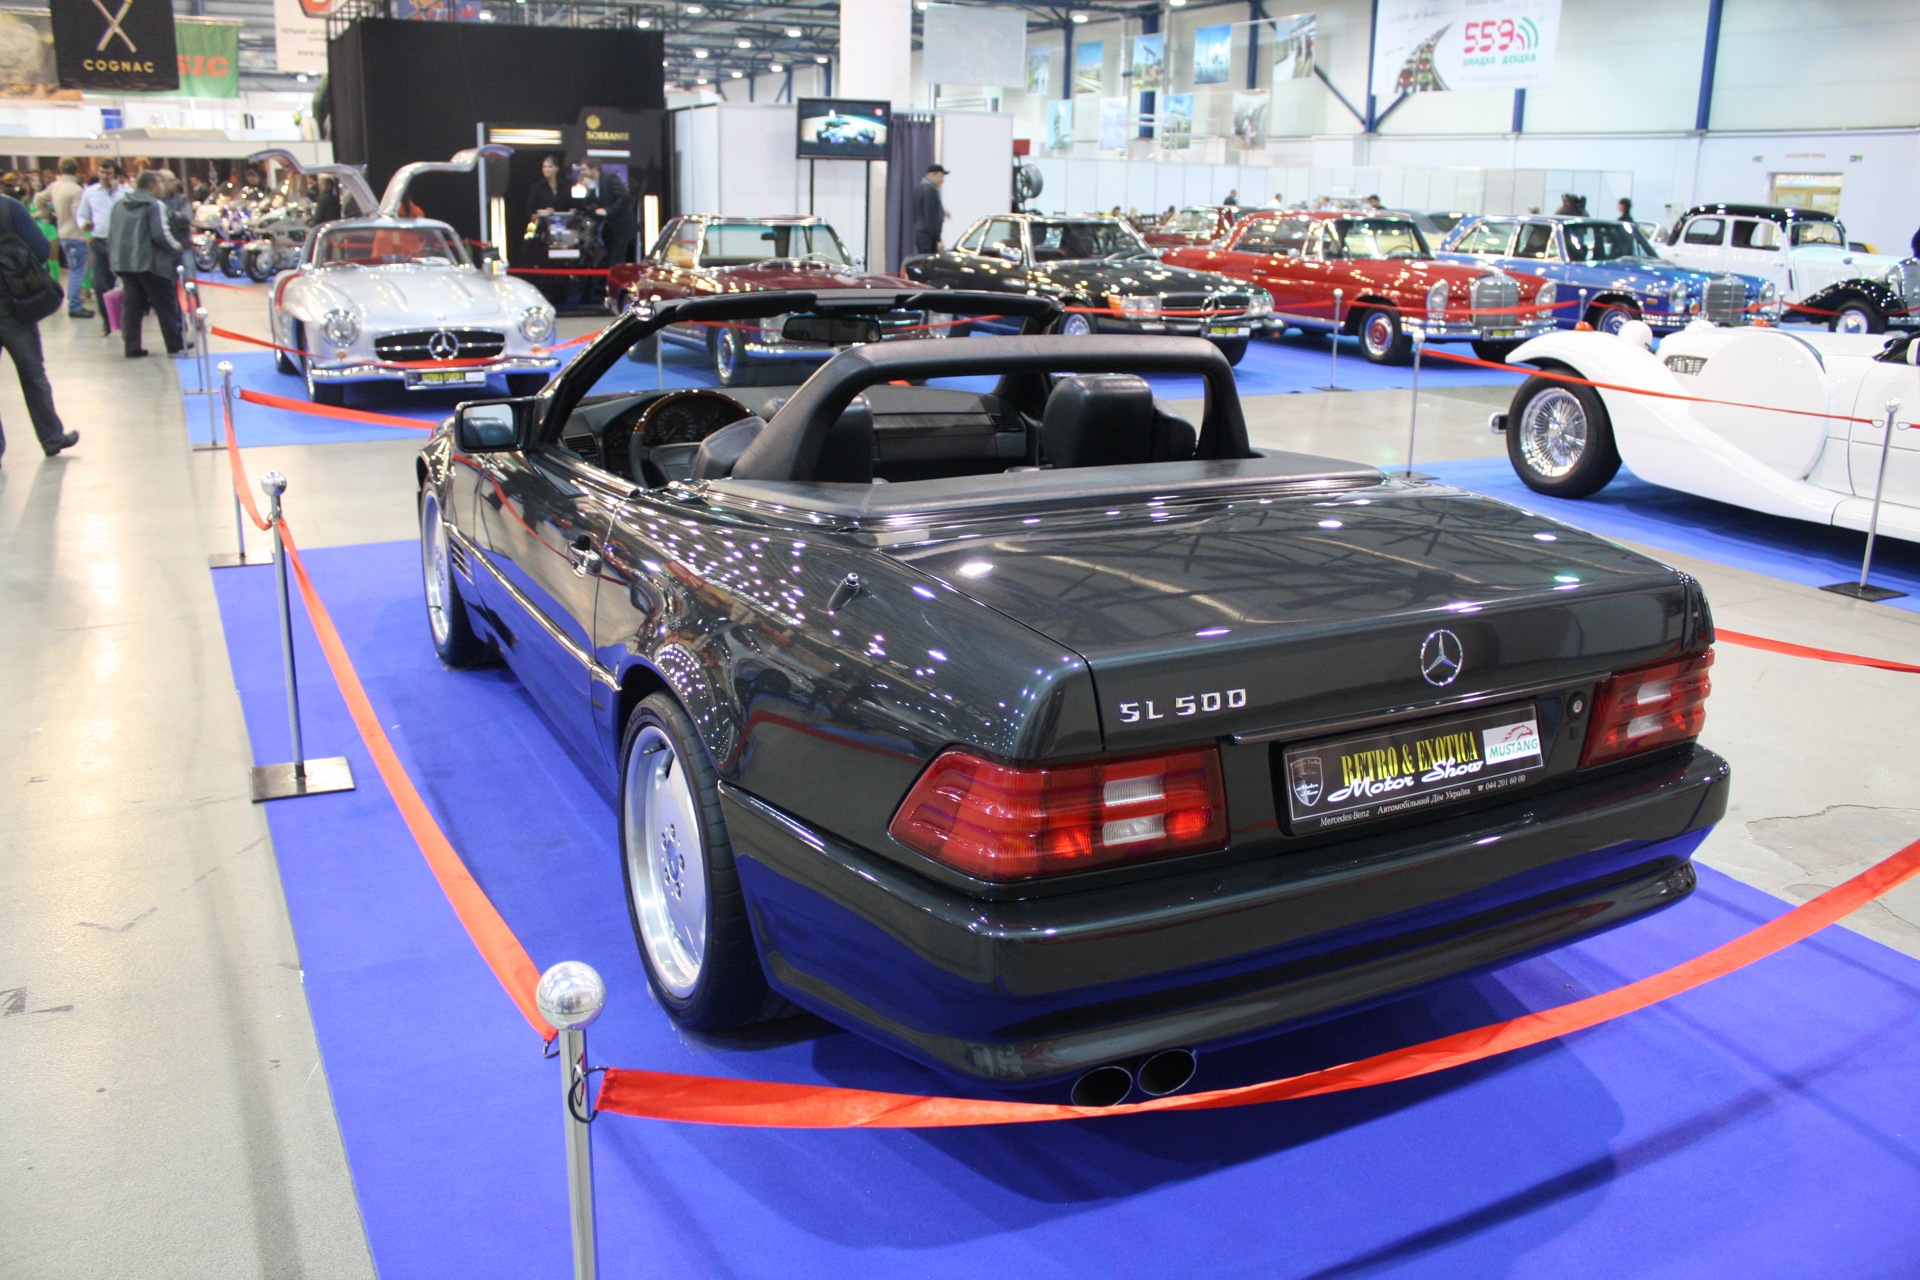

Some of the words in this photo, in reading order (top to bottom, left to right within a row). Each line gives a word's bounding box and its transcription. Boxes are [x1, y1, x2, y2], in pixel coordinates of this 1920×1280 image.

[1463, 19, 1515, 54] 559
[82, 59, 155, 73] COGNAC
[1119, 700, 1164, 723] SL
[1175, 688, 1247, 716] 500
[1341, 746, 1399, 787] RETRO
[1401, 743, 1416, 775] &
[1416, 731, 1478, 771] EXOTICA
[1489, 738, 1539, 759] MUSTANG
[1327, 775, 1415, 802] Motor
[1421, 757, 1484, 783] Show
[1320, 811, 1370, 827] Mercedes-Benz
[1377, 796, 1430, 815] Автомобільний
[1430, 794, 1444, 804] Дім
[1445, 788, 1471, 801] Україна
[1485, 781, 1497, 790] 044
[1498, 778, 1508, 788] 201
